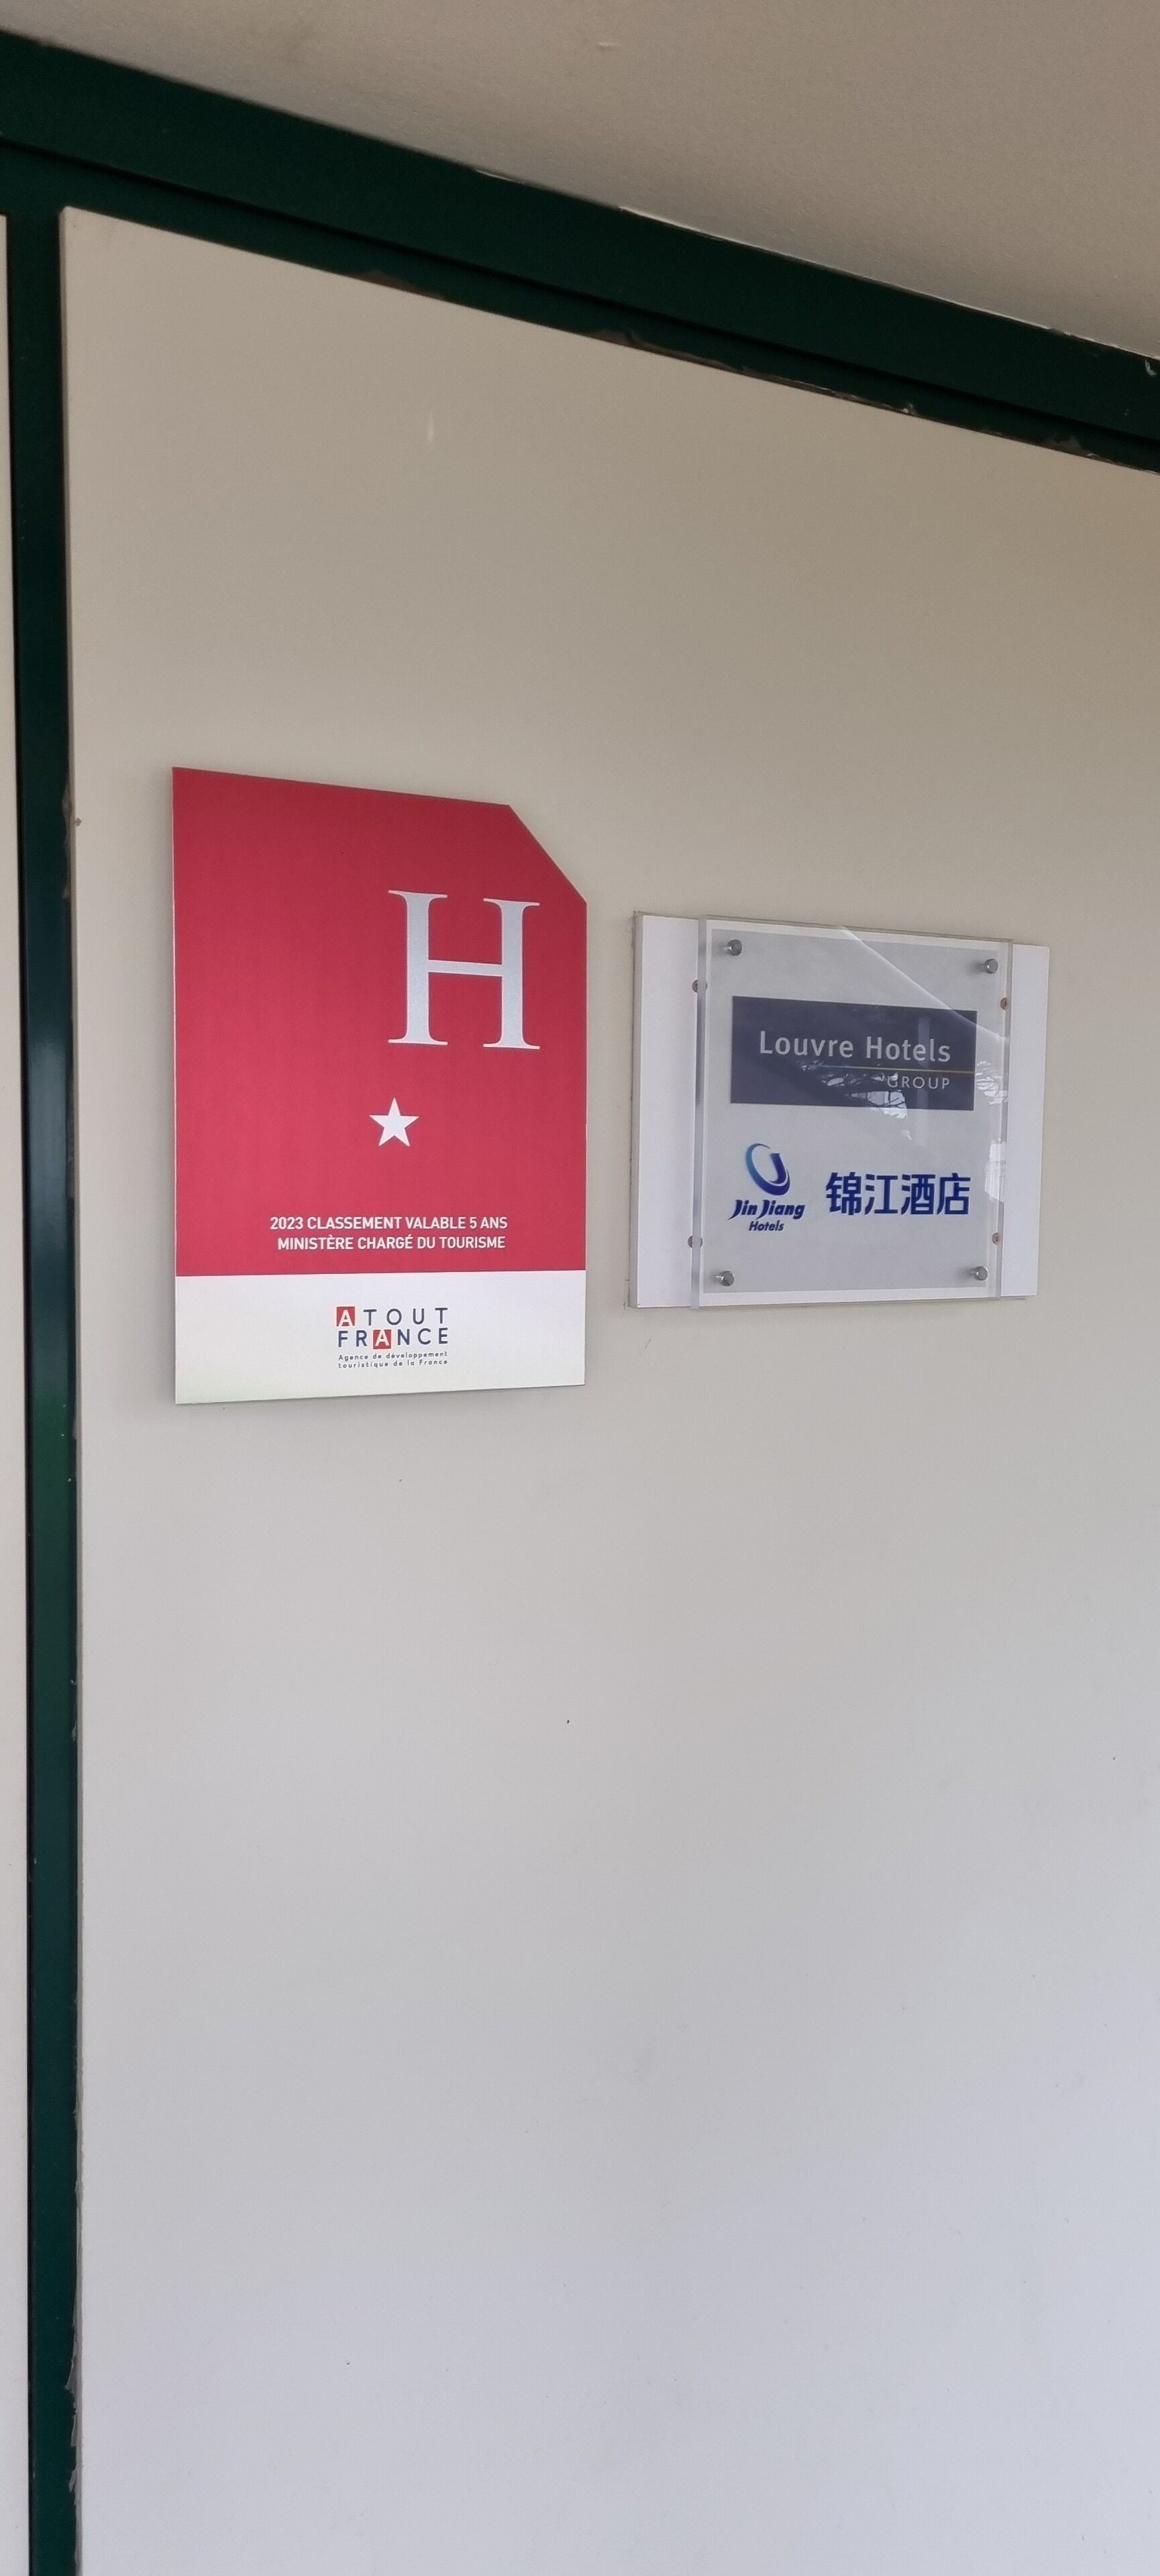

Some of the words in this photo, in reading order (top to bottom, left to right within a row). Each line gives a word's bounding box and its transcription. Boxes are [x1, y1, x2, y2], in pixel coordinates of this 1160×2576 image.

[388, 890, 540, 1050] H
[759, 1030, 854, 1058] Louvre
[865, 1036, 951, 1063] Hotels
[887, 1076, 950, 1089] GROUP
[825, 1171, 971, 1216] 锦江酒店
[270, 1216, 303, 1230] 2023
[307, 1216, 403, 1230] CLASSEMENT
[405, 1216, 466, 1230] VALABLE
[469, 1216, 478, 1230] 5
[480, 1216, 509, 1230] ANS
[748, 1220, 785, 1232] Hotels
[277, 1234, 354, 1250] MINISTÈRE
[357, 1234, 414, 1250] CHARGÉ
[417, 1236, 436, 1249] DU
[439, 1236, 507, 1249] TOURISME
[335, 1307, 449, 1327] ATOUT
[337, 1328, 449, 1348] FRANCE
[338, 1354, 369, 1362] Agence
[386, 1351, 448, 1360] développement
[337, 1361, 389, 1369] touristique
